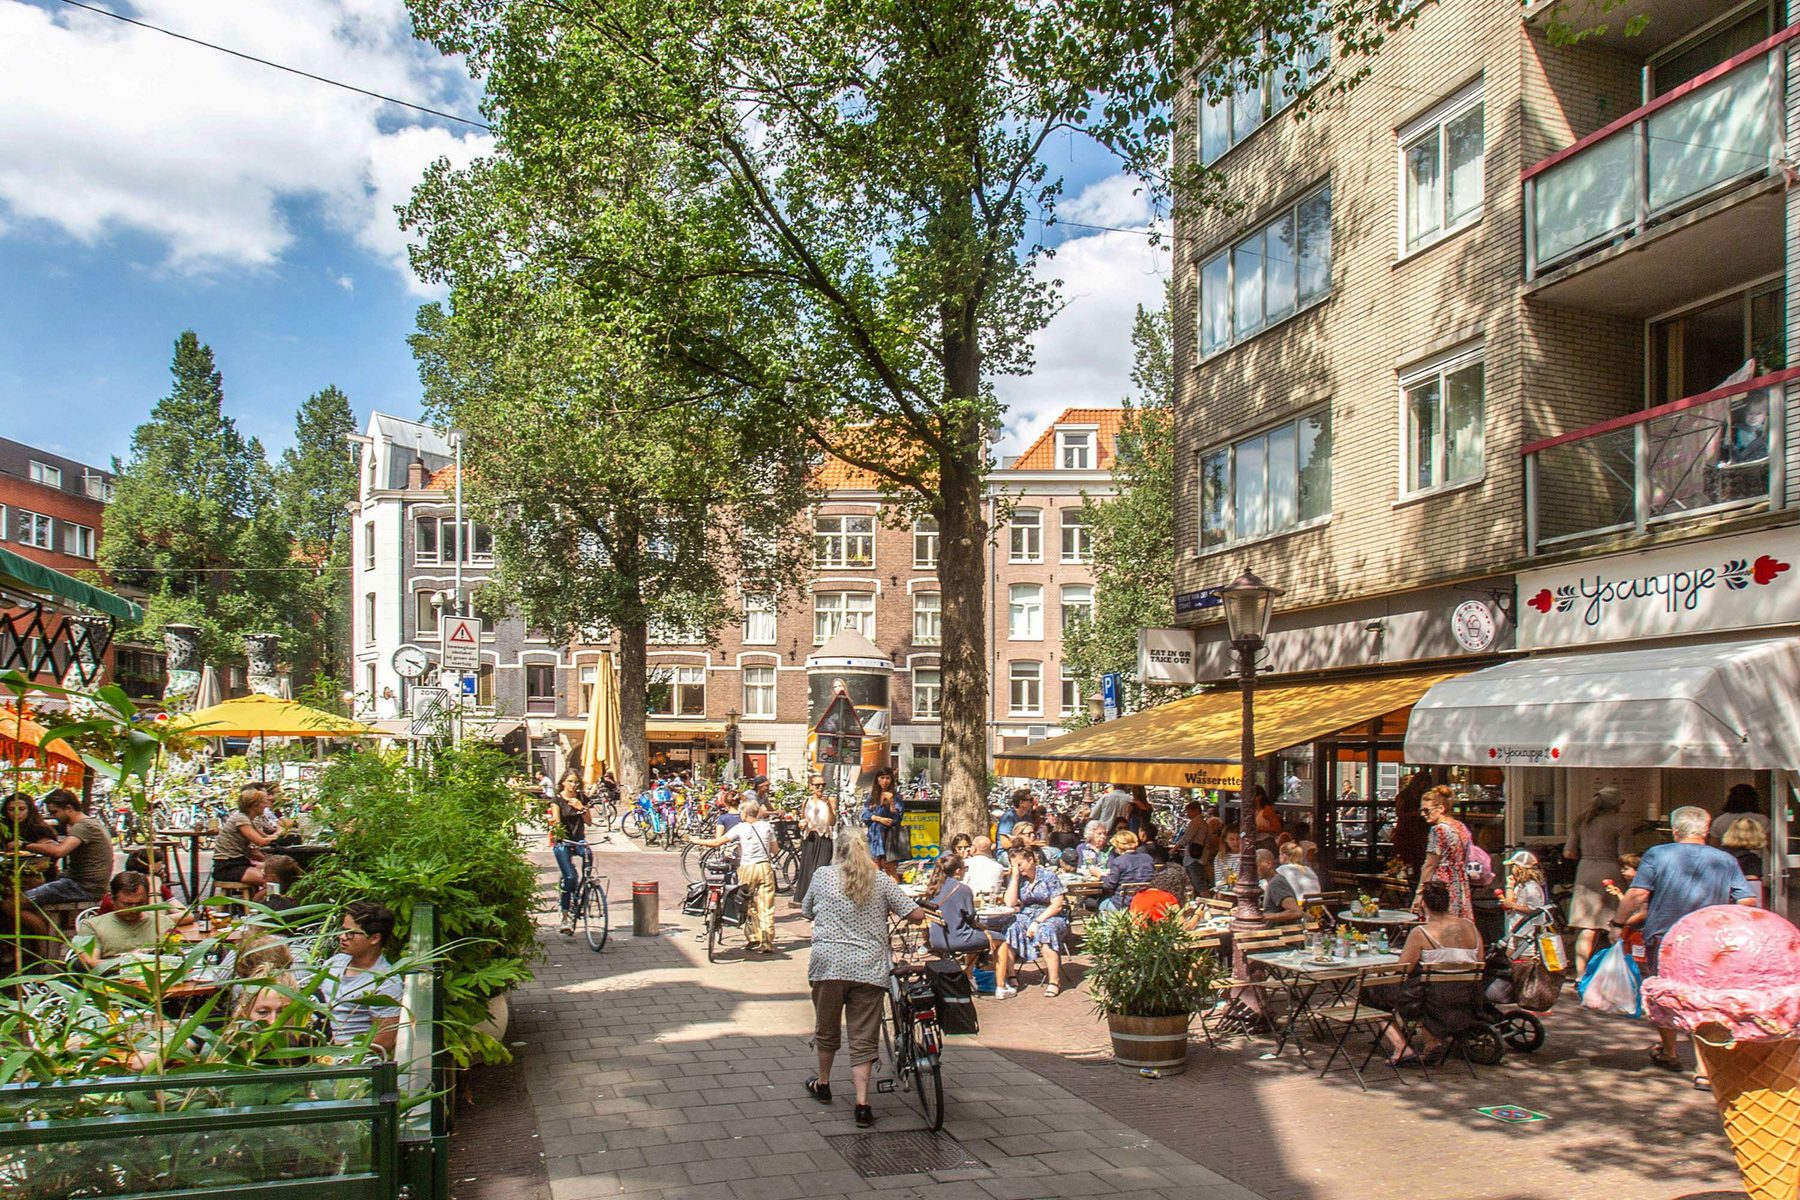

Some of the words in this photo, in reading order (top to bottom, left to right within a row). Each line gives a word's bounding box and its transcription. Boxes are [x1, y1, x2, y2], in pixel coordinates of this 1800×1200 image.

[1178, 650, 1191, 658] OR
[1104, 676, 1112, 695] P
[1197, 769, 1207, 777] de
[1184, 773, 1242, 786] Wasserette
